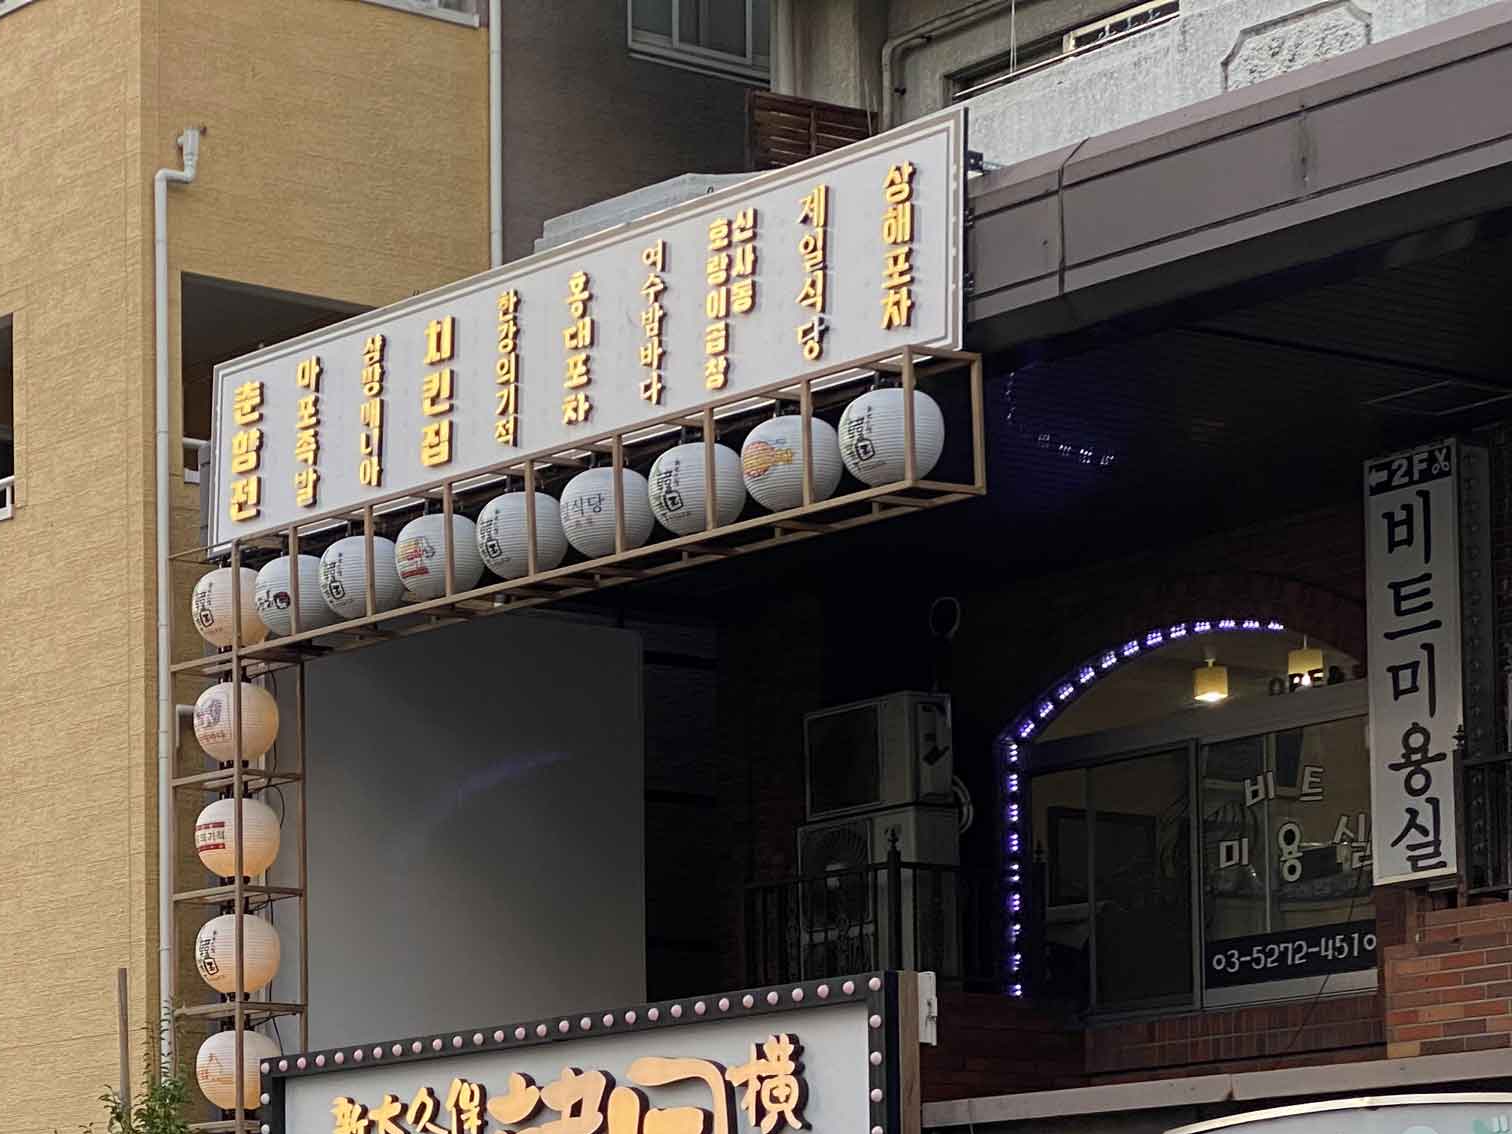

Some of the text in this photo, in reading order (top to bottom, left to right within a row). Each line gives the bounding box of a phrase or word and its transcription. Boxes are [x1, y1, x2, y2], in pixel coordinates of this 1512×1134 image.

[732, 207, 758, 314] 신사동
[880, 160, 916, 330] 상해포차
[421, 314, 455, 468] 치킨집
[495, 287, 520, 448] 한강의기적
[562, 271, 595, 425] 홍대포차
[640, 239, 667, 407] 여수밤바다
[229, 380, 264, 523] 춘향전
[295, 355, 323, 508] 마포족발
[1391, 452, 1429, 487] 2F
[1380, 488, 1448, 875] 비트미용실
[1219, 812, 1373, 883] 미용실
[1243, 763, 1325, 808] 비트
[1213, 933, 1377, 972] 03-5272-4510
